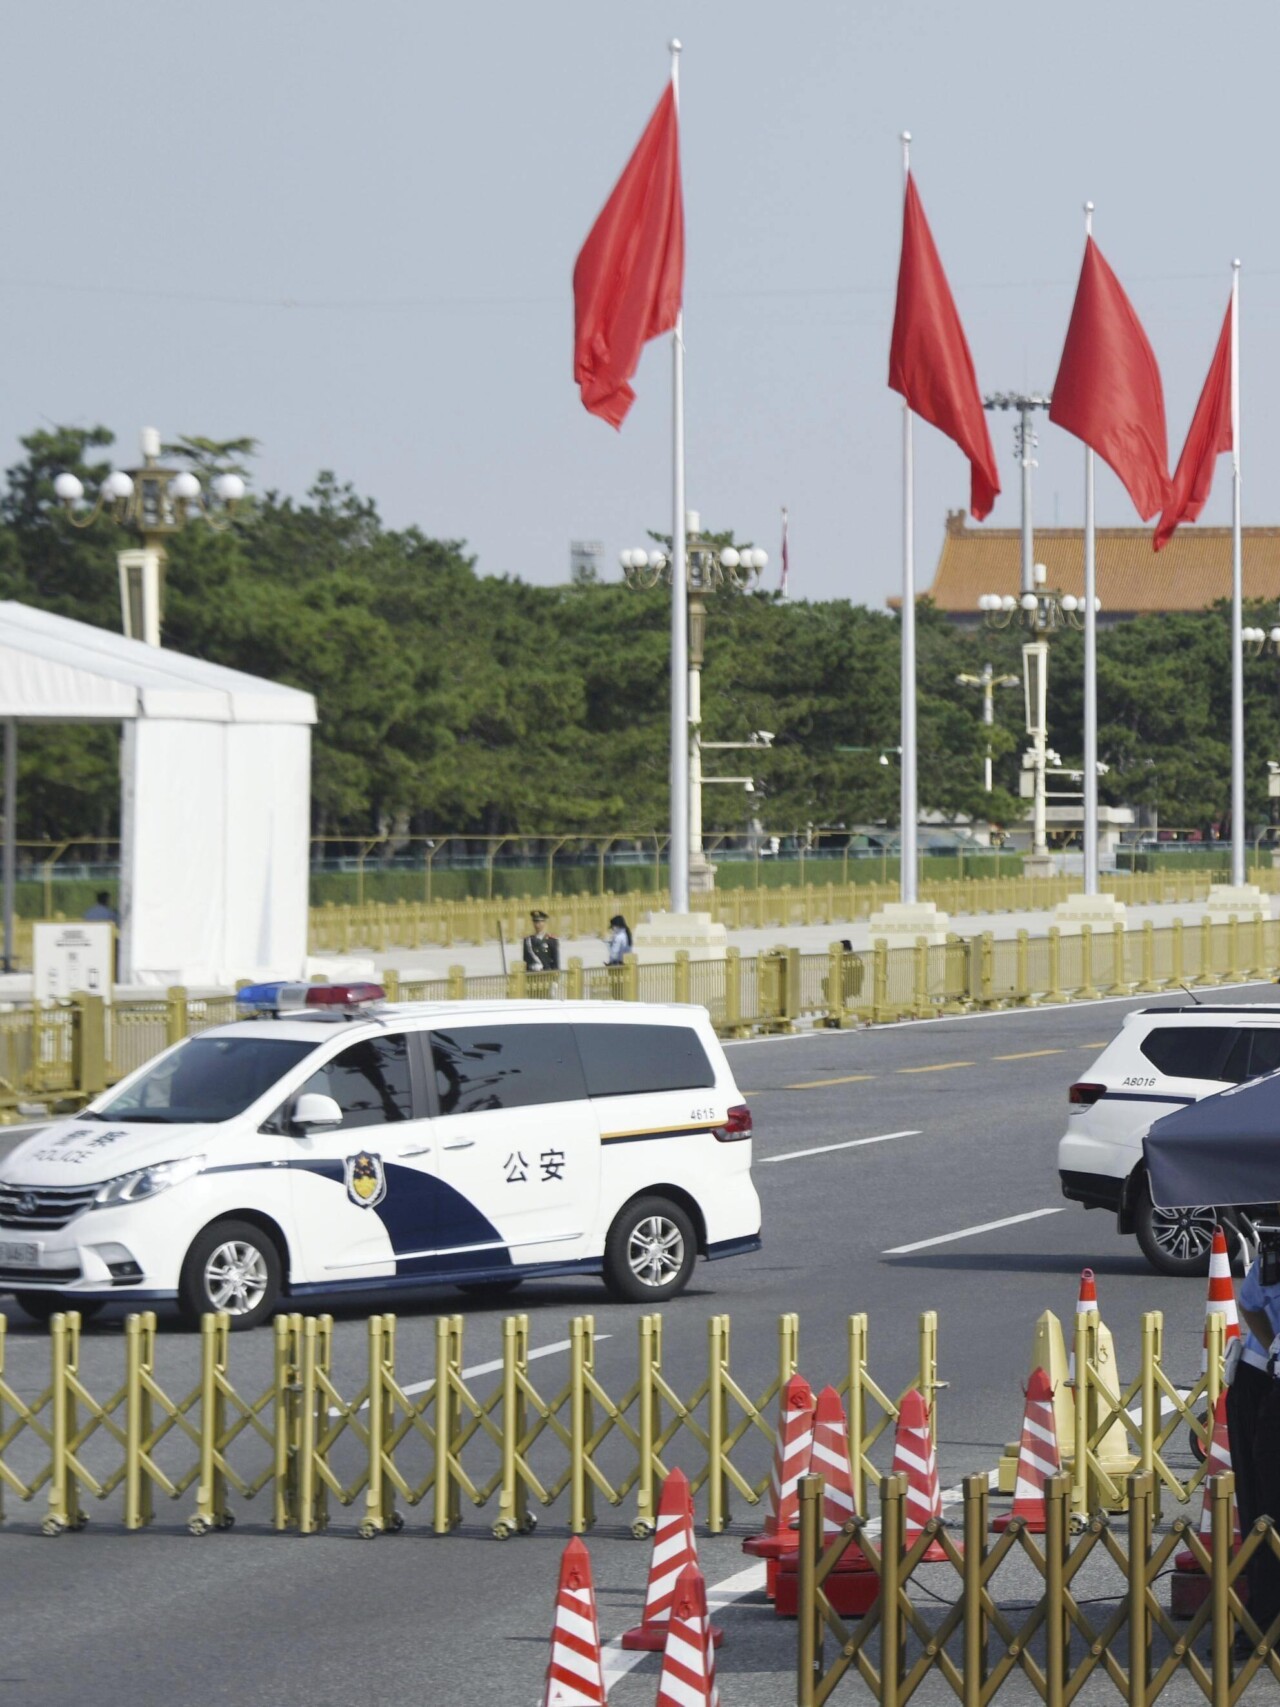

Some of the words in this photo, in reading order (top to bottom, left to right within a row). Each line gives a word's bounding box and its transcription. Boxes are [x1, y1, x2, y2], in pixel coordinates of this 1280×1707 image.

[1122, 1077, 1157, 1087] A8016
[690, 1107, 715, 1121] 4615
[503, 1148, 565, 1184] 公安
